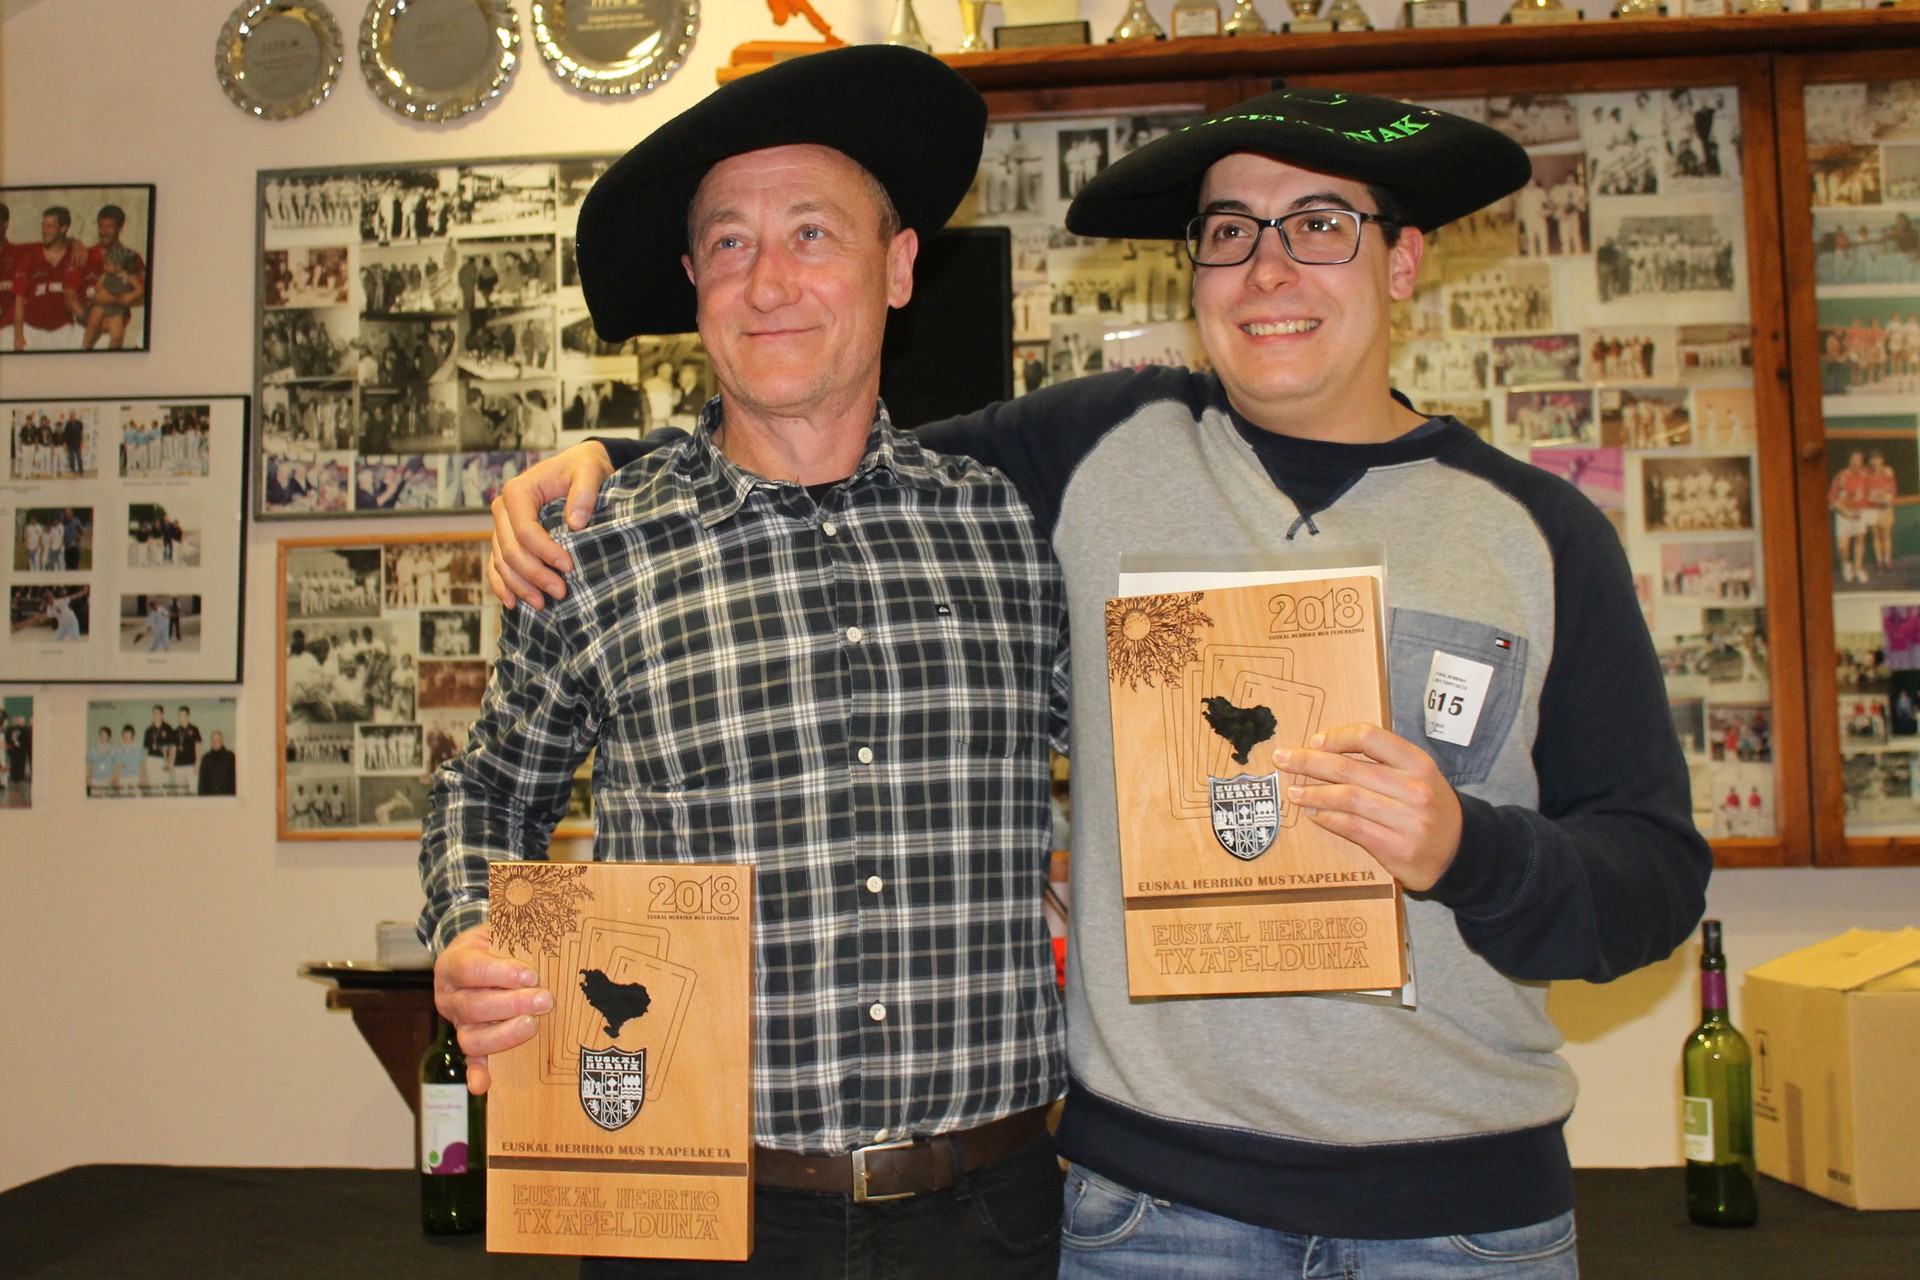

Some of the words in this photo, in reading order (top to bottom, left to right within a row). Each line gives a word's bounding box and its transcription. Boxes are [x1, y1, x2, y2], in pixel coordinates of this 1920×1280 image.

[1268, 587, 1364, 633] 2018
[1217, 658, 1225, 670] 7
[1427, 689, 1465, 716] G15
[1215, 782, 1271, 794] EUSKAL
[1215, 789, 1272, 800] HERRIA
[1138, 880, 1189, 892] EUSKAL
[1192, 877, 1253, 889] HERRIKO
[1257, 875, 1286, 887] MUS
[1290, 871, 1376, 885] TXAPELKETA
[648, 874, 740, 916] 2018
[595, 932, 602, 943] 7
[1152, 921, 1250, 946] EUSKAL
[1259, 916, 1368, 942] HERRIKO
[1154, 941, 1370, 975] TXAPELDUNA
[585, 1055, 640, 1064] EUSKAL
[585, 1062, 640, 1071] HERRIA
[502, 1141, 551, 1153] EUSKAL
[555, 1143, 614, 1155] HERRIKO
[618, 1145, 645, 1156] MUS
[648, 1146, 731, 1159] TXAPELKETA
[512, 1184, 607, 1208] EUSKAL
[617, 1187, 720, 1212] HERRIKO
[513, 1208, 720, 1241] TXAPELDUNA
